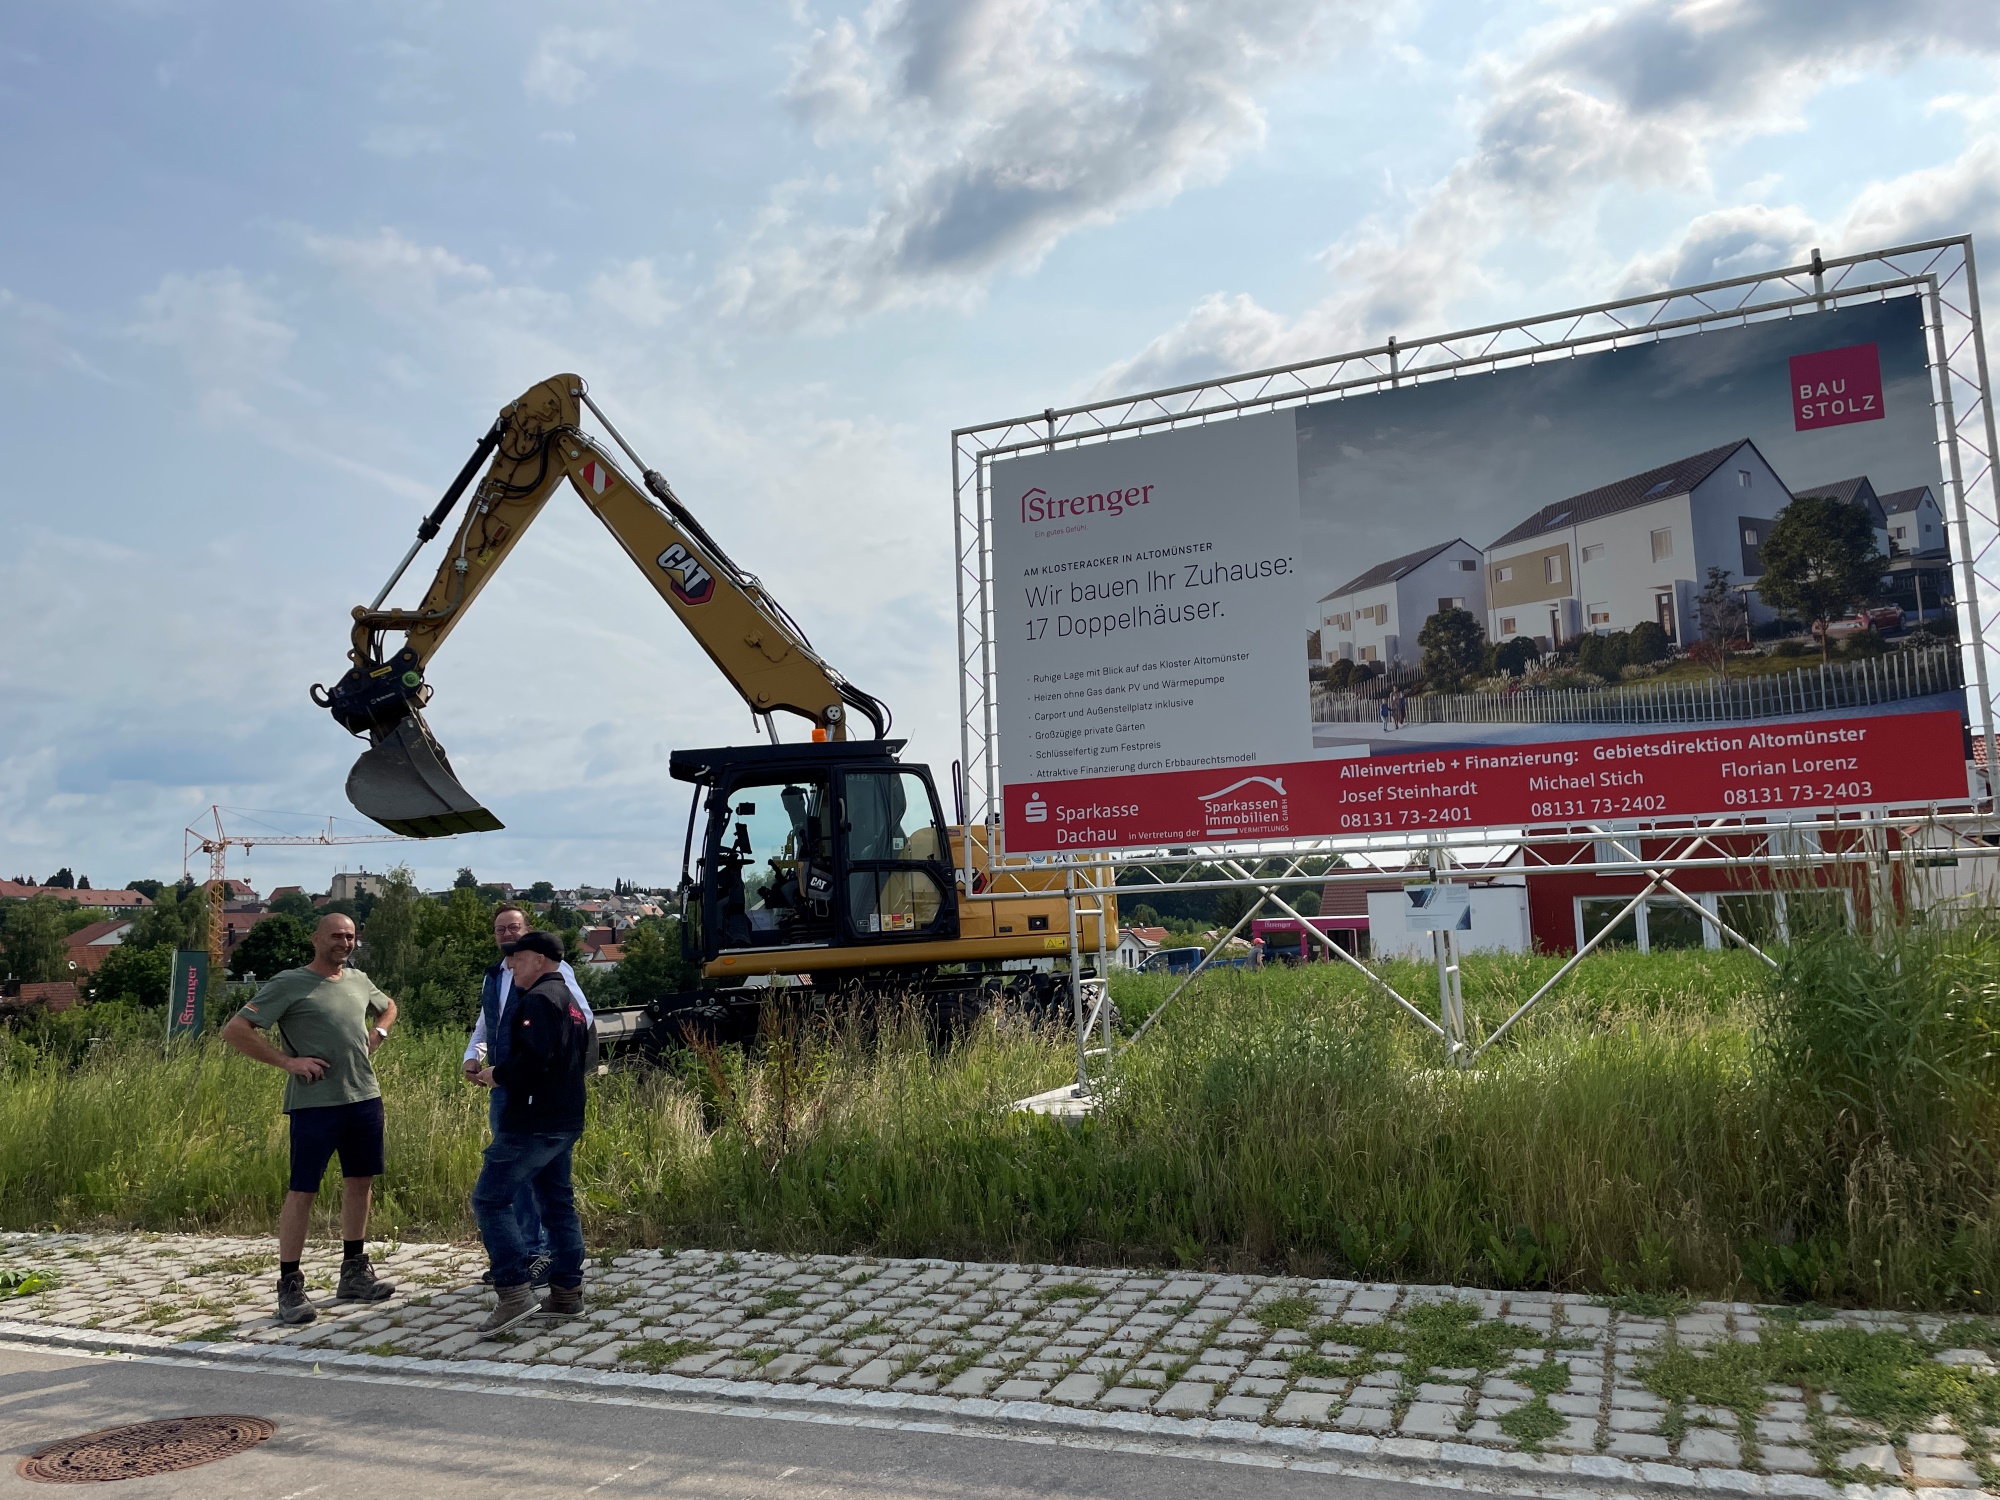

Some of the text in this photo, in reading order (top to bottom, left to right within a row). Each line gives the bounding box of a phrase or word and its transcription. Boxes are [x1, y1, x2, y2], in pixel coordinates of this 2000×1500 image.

[1800, 379, 1845, 399] BAU
[1802, 395, 1875, 419] STOLZ
[1028, 484, 1155, 522] Strenger
[659, 544, 711, 592] CAT
[1024, 542, 1212, 577] AM KLOSTERACKER IN ALTOMÜNSTER
[1025, 557, 1293, 608] Wir bauen Ihr Zuhause:
[1026, 600, 1225, 641] 17 Doppelhäuser.
[1033, 653, 1249, 683] Ruhige Lage mit Blick auf das Kloster Altomünster
[1034, 676, 1225, 701] Heizen ohne Gas dank PV und Wärmepumpe
[1034, 699, 1194, 721] Carport und Außenstellplatz inklusive
[1035, 723, 1145, 740] Großzügige private Gärten
[1036, 742, 1161, 759] Schlüsselfertig zum Festpreis
[1340, 727, 1866, 779] Alleinvertrieb + Finanzierung: Gebietsdirektion Altomünster
[1037, 752, 1256, 778] Attraktive Finanzierung durch Erbbaurechtsmodell
[1722, 756, 1858, 778] Florian Lorenz
[1530, 769, 1643, 791] Michael Stich
[1339, 781, 1478, 803] Josef Steinhardt
[1724, 781, 1872, 805] 08131 73-2403
[1056, 803, 1139, 824] Sparkasse
[1205, 799, 1278, 815] Sparkassen
[1531, 795, 1666, 817] 08131 73-2402
[1205, 811, 1279, 825] Immobilien
[1341, 807, 1472, 828] 08131 73-2401
[1057, 826, 1116, 844] Dachau
[1129, 829, 1200, 840] in Vertretung der
[1239, 825, 1289, 833] VERMITTLUNGS
[810, 876, 827, 890] CAT
[1266, 921, 1292, 929] Strenger
[183, 965, 199, 1021] Strenger
